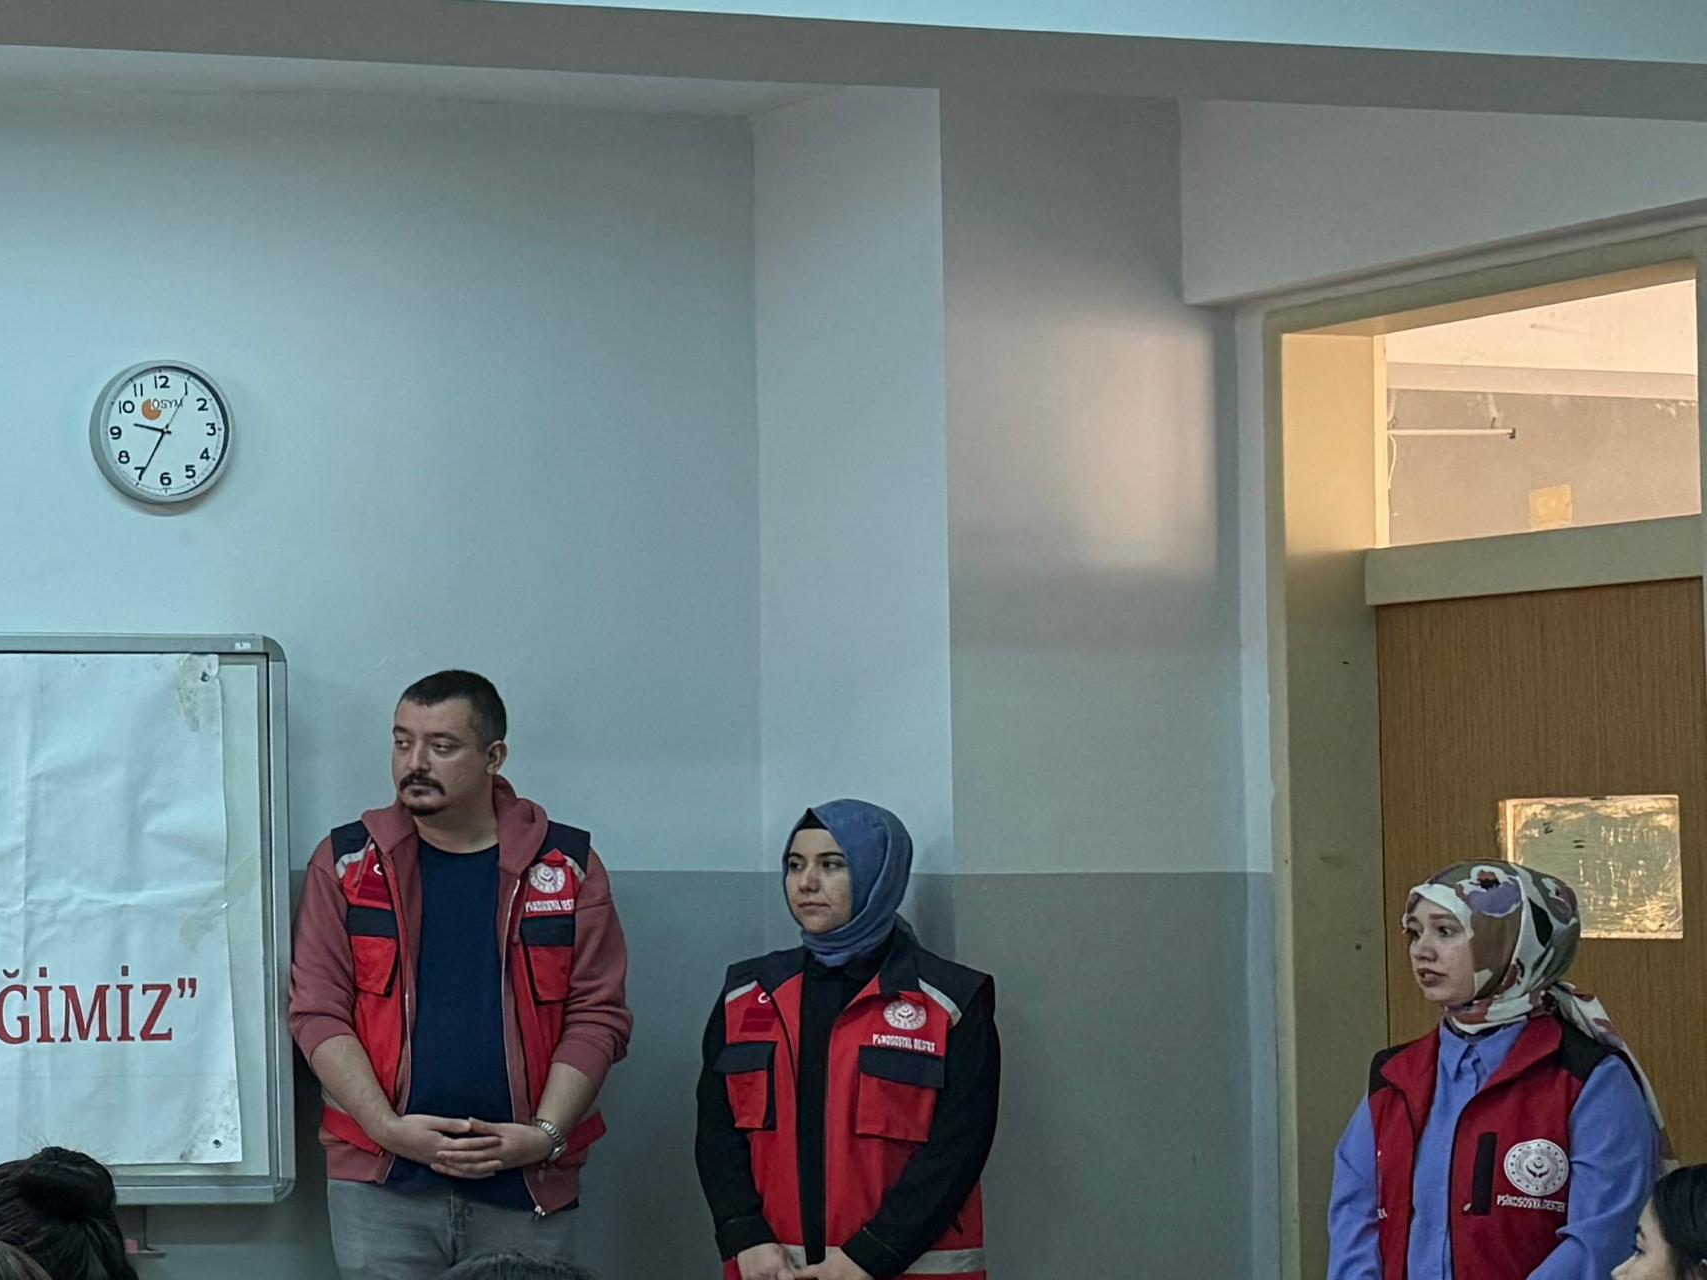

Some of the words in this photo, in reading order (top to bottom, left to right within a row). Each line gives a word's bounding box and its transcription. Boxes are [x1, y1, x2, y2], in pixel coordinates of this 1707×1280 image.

[154, 375, 170, 389] 12
[133, 383, 143, 397] 11
[118, 400, 135, 414] 10
[196, 398, 208, 412] 2
[109, 426, 122, 440] 9
[205, 422, 217, 436] 3
[118, 450, 130, 464] 8
[199, 447, 210, 462] 4
[134, 466, 146, 481] 7
[159, 472, 172, 486] 6
[185, 465, 196, 479] 5
